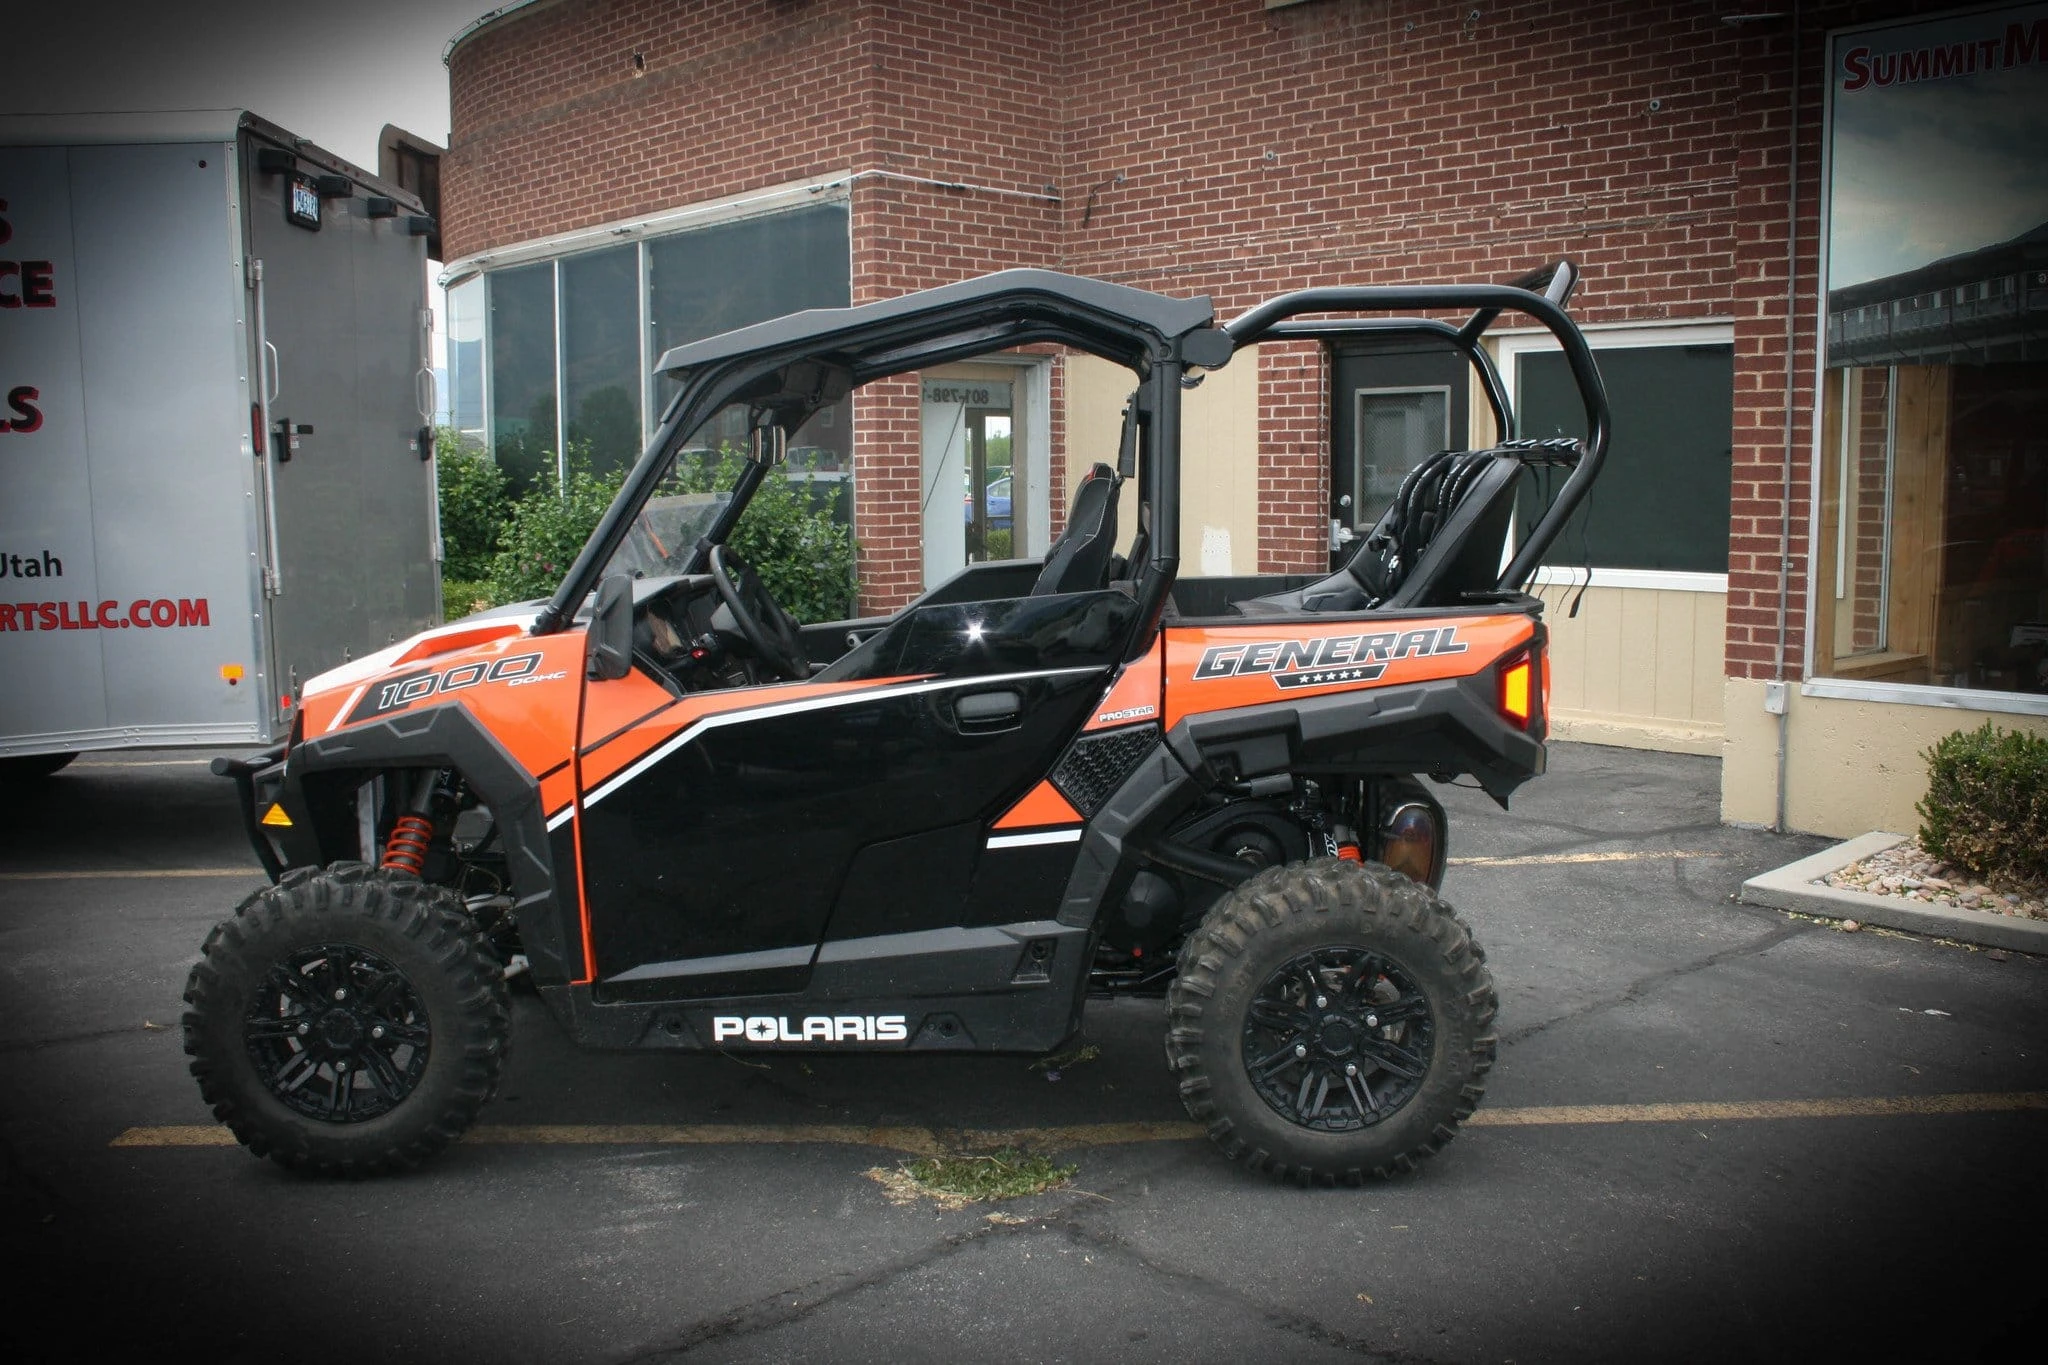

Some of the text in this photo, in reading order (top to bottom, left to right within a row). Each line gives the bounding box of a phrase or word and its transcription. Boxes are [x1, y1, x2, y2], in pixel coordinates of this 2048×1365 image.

[0, 598, 210, 632] RTSLLC.COM
[1191, 625, 1470, 681] GENERAL
[378, 652, 544, 710] 1000
[507, 670, 568, 687] DOHC
[1098, 704, 1155, 722] PROSTAR
[713, 1015, 908, 1041] POLARIS
